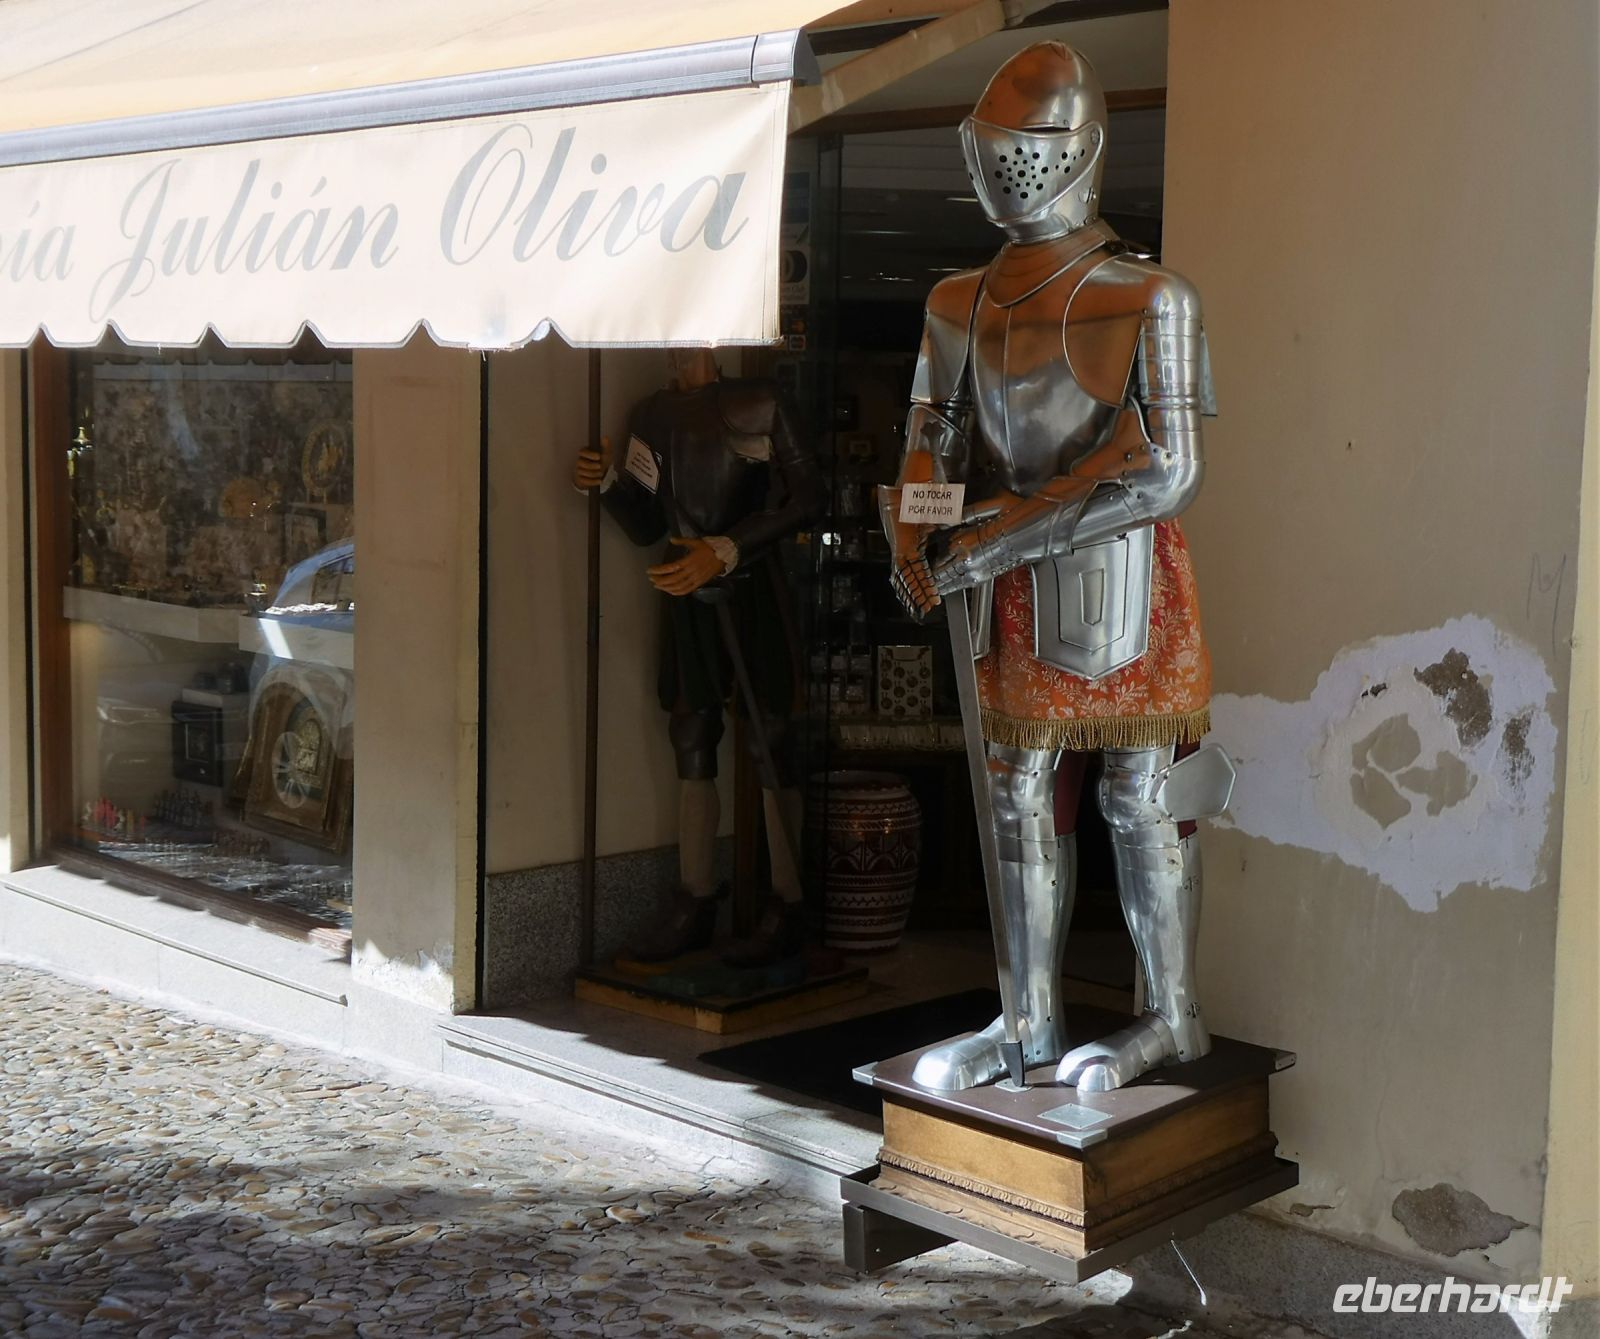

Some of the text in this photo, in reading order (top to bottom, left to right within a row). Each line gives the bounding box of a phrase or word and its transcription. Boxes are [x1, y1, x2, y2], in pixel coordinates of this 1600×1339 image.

[0, 124, 750, 323] ía Julián Oliva
[912, 490, 952, 500] NO TOCAR
[927, 506, 953, 515] FAVOR
